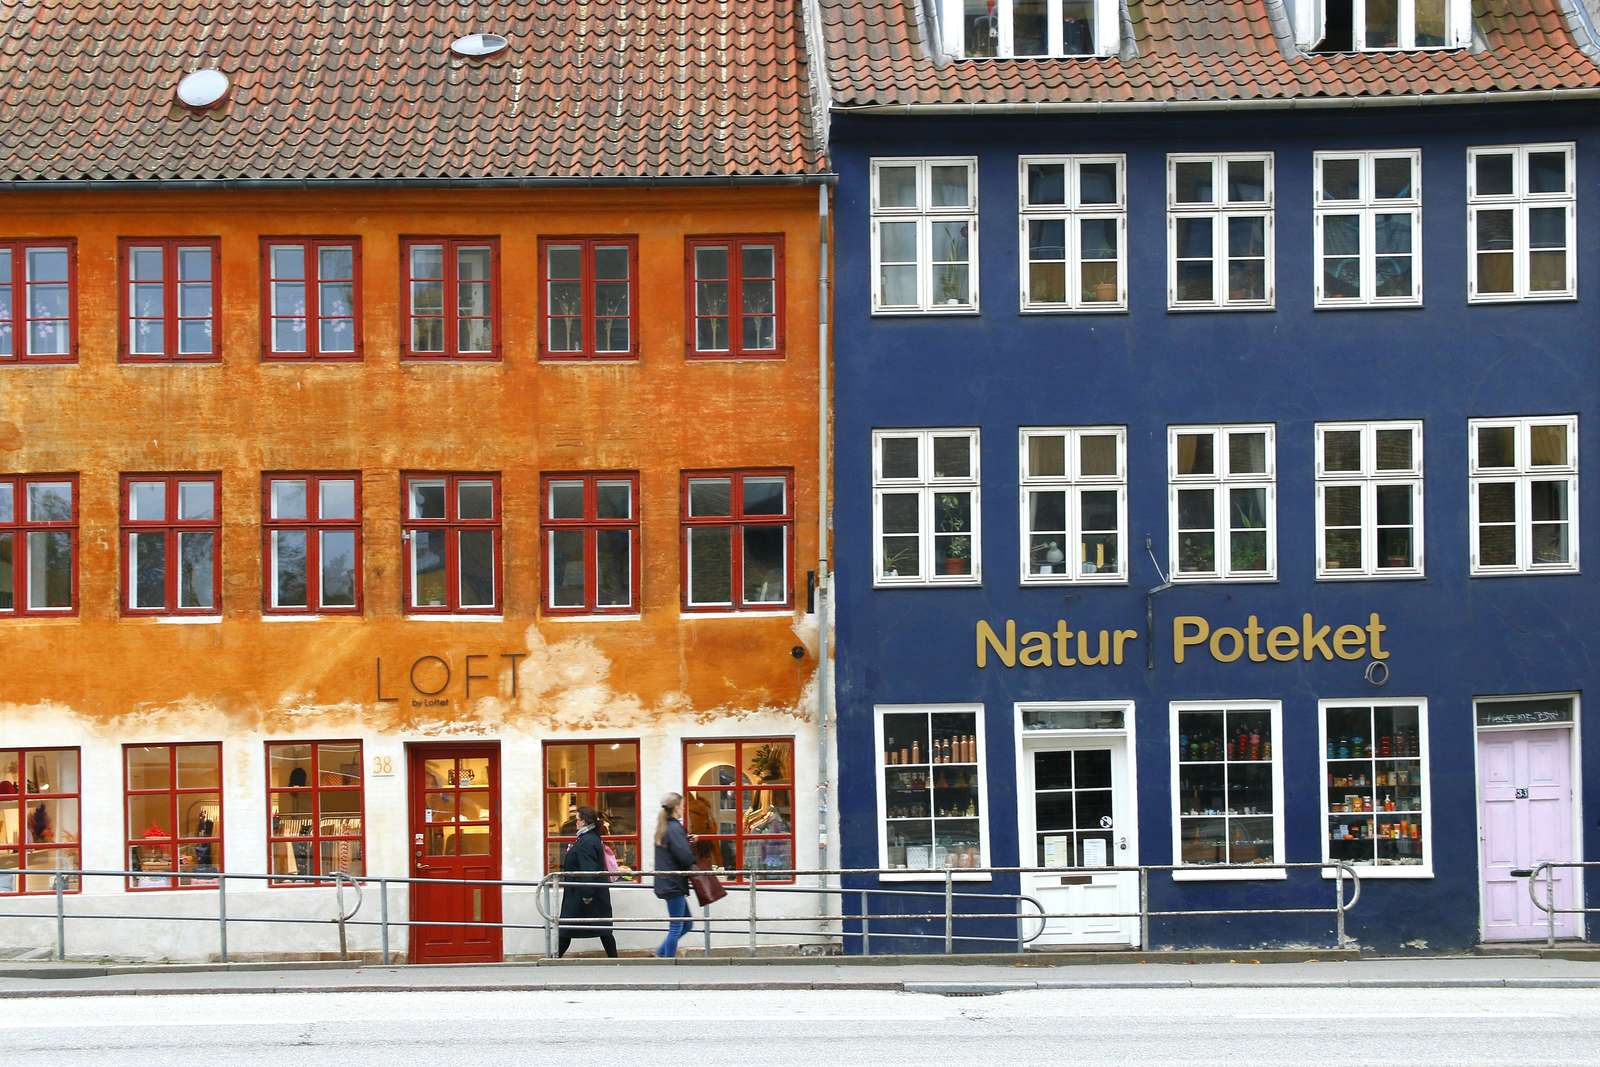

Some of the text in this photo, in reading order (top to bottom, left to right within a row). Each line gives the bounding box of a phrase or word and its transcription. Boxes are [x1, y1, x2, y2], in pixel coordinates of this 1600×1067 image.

[976, 612, 1390, 668] Natur Poteket
[377, 653, 527, 702] LOFT
[373, 755, 393, 774] 38
